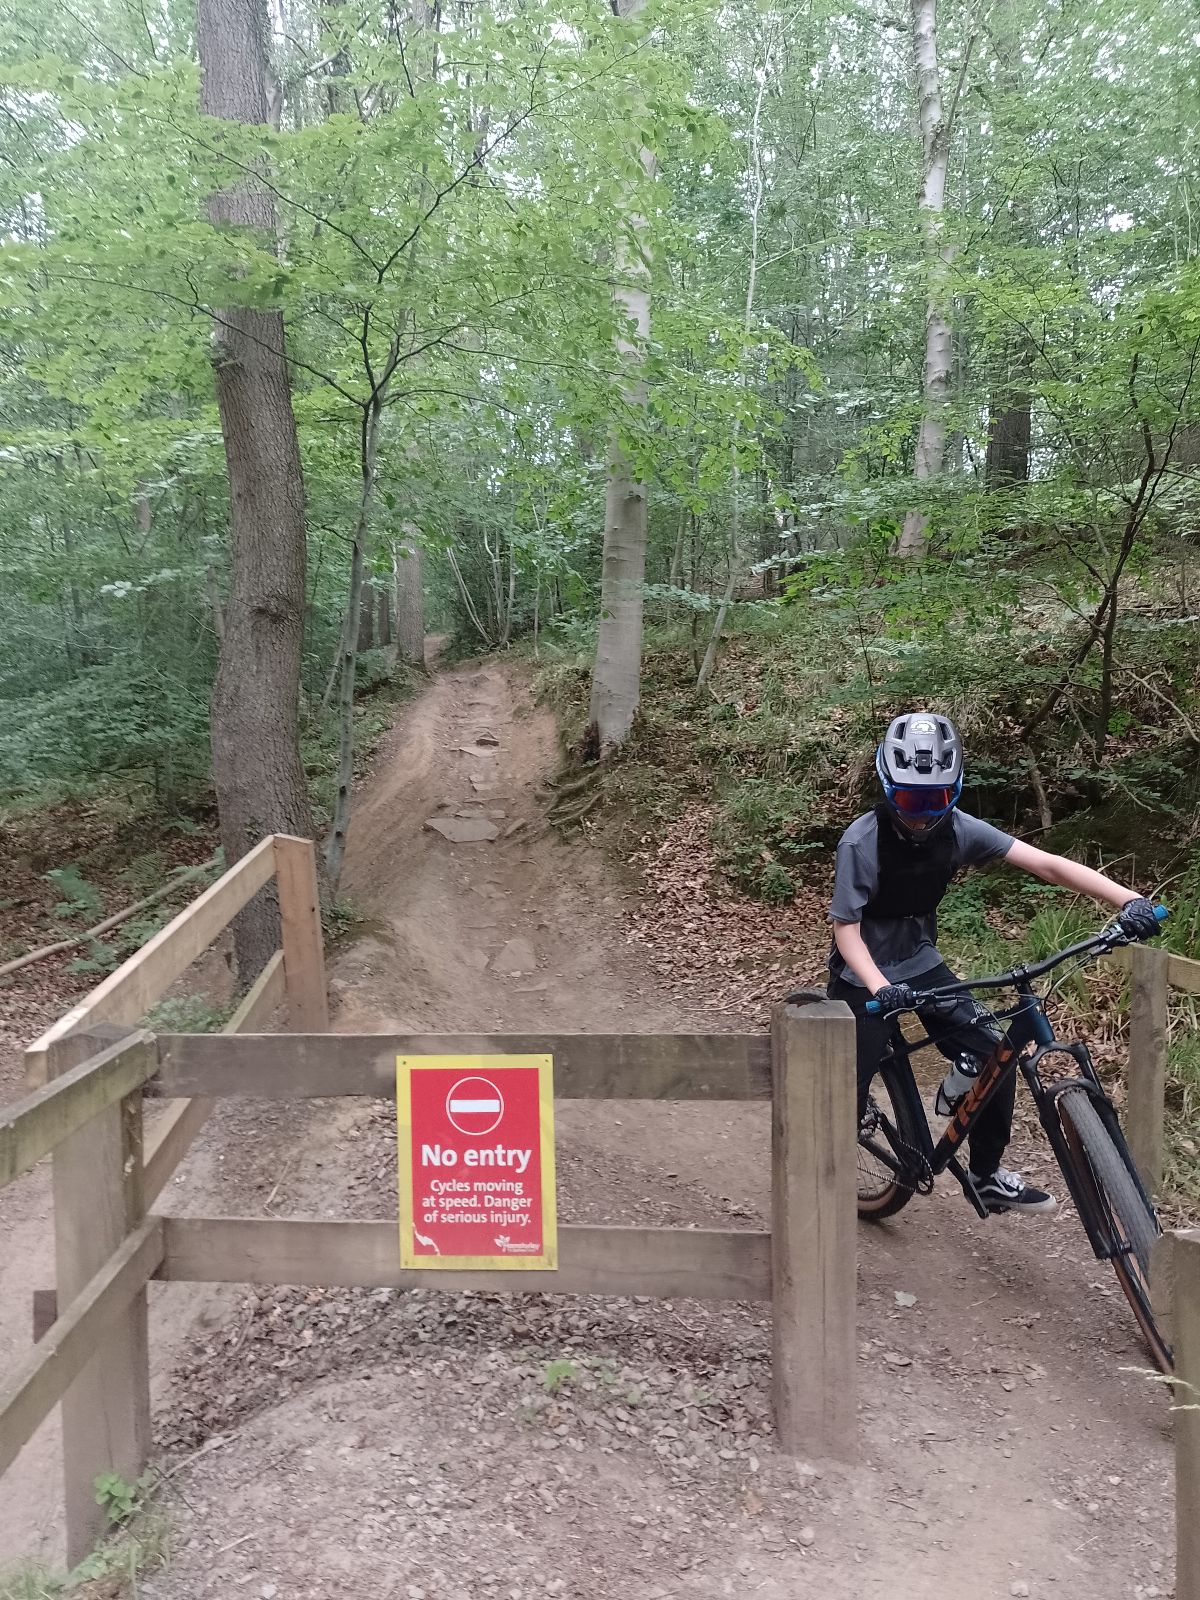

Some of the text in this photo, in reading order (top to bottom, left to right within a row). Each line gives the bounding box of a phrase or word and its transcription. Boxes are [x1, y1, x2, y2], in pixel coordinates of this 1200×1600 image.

[421, 1143, 532, 1174] No entry
[430, 1178, 524, 1196] Cycles moving
[421, 1194, 533, 1212] at speed. Danger
[423, 1210, 532, 1227] of serious injury.
